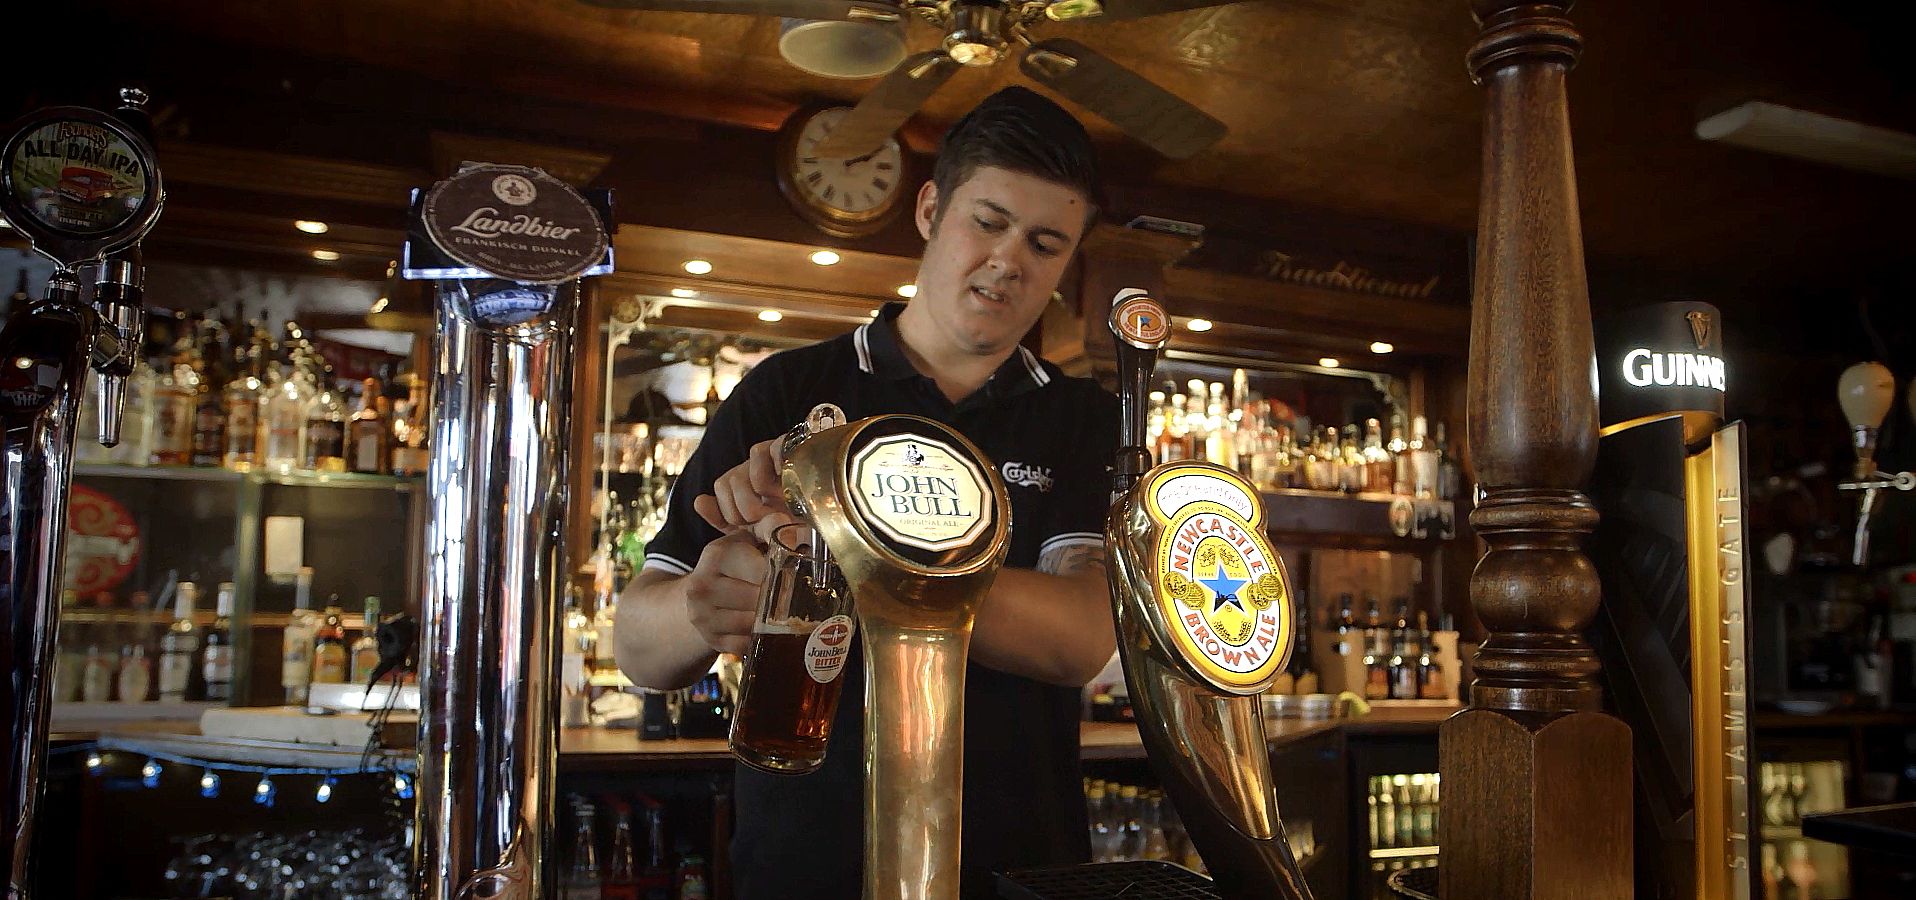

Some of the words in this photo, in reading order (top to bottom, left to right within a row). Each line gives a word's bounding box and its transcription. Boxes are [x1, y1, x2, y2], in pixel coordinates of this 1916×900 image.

[24, 139, 61, 158] ALL
[67, 142, 106, 165] DAY
[110, 151, 140, 177] IPA
[451, 206, 580, 240] Landbier
[532, 245, 582, 256] DUNKEL
[1623, 348, 1725, 392] GUINNE
[872, 473, 960, 498] JOHN
[890, 495, 972, 519] BULL
[1174, 518, 1265, 574] NEWCASTLE
[1717, 487, 1741, 586] GATE
[1185, 613, 1261, 666] BROWN
[1256, 613, 1276, 652] ALE
[815, 656, 841, 666] BITTER
[1721, 609, 1746, 785] JAMES'S
